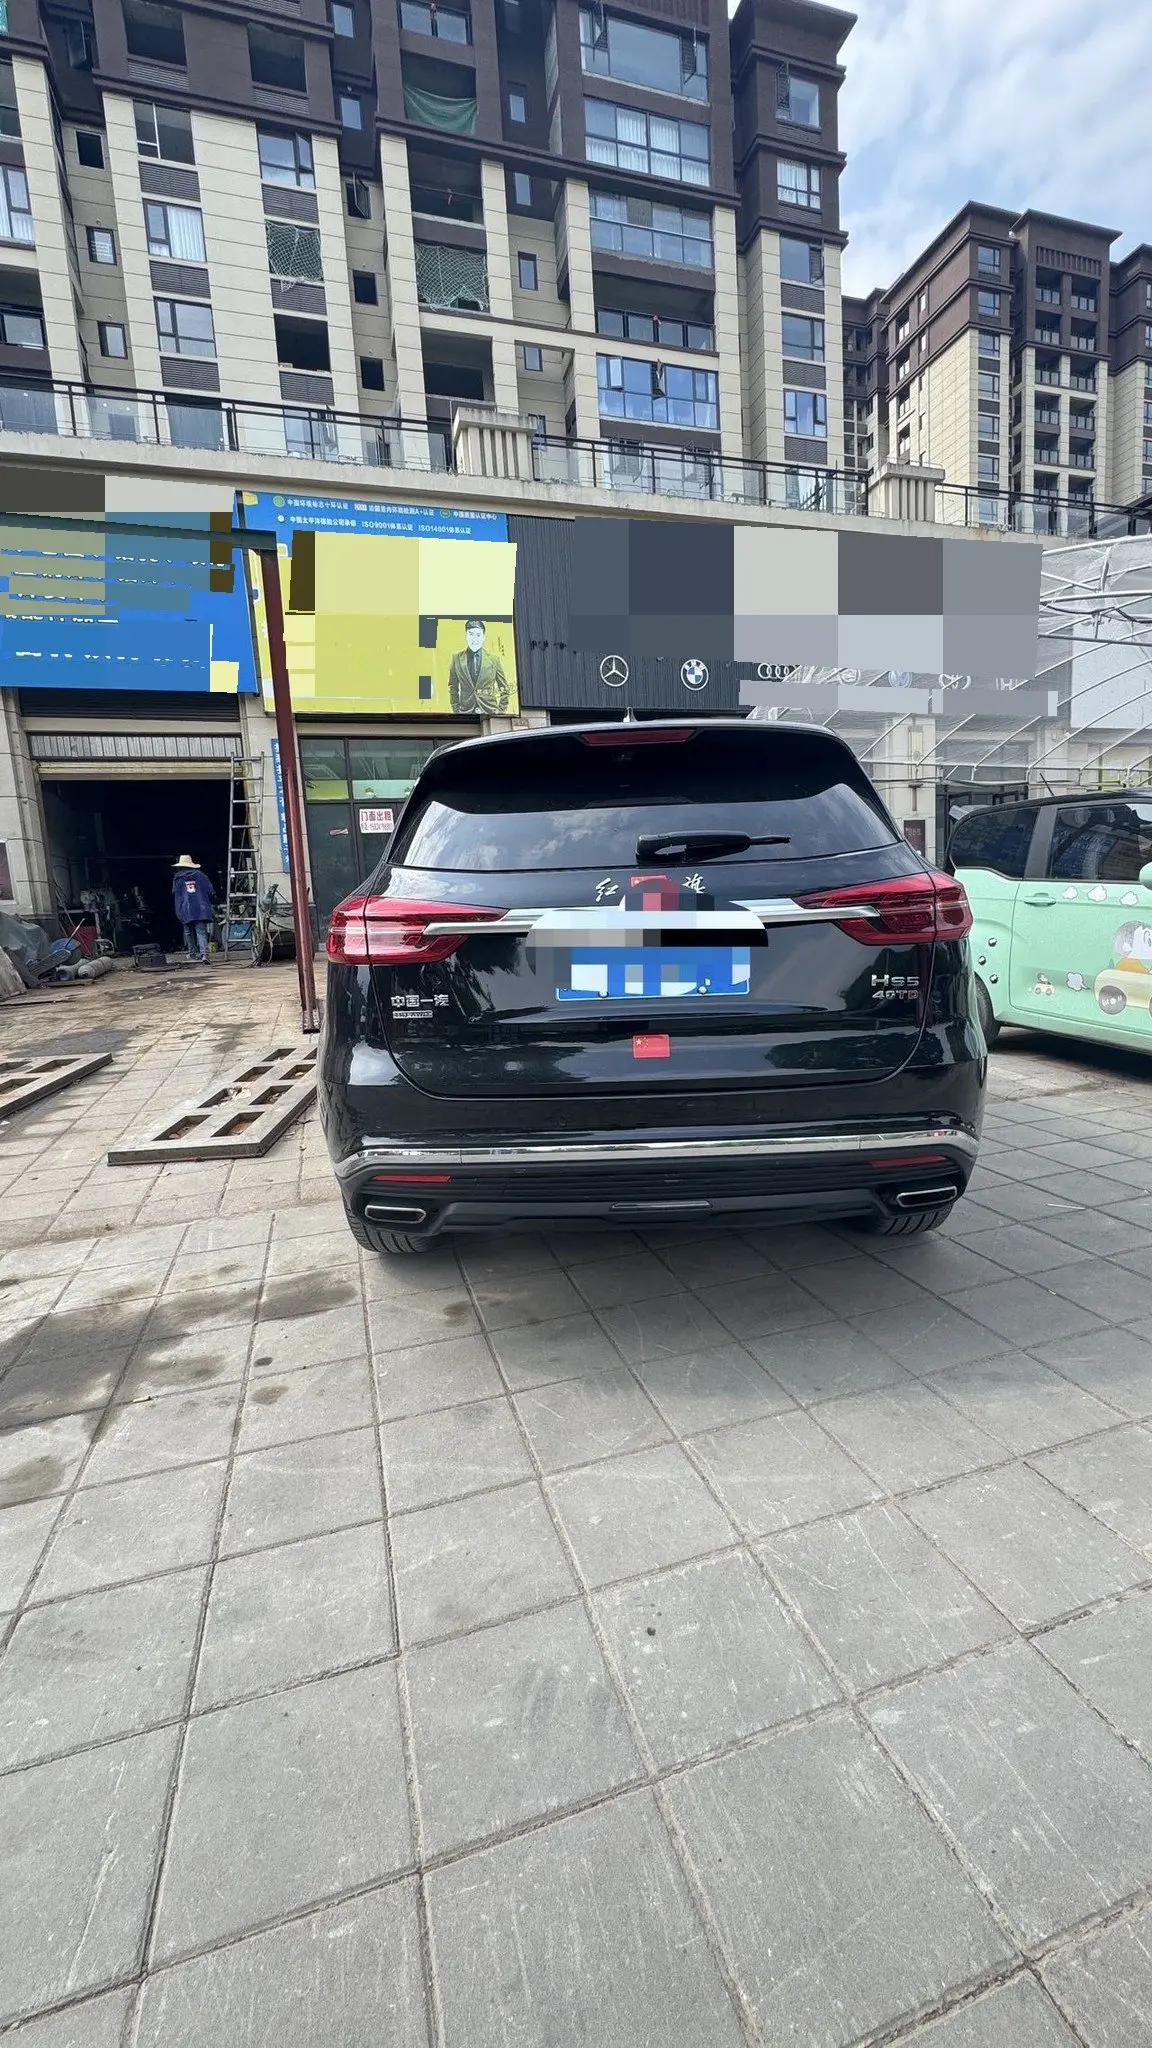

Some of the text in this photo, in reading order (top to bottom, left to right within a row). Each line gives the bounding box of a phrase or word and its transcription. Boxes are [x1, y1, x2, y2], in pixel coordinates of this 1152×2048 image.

[361, 811, 391, 821] 门面出租
[871, 974, 920, 987] HS5
[391, 994, 449, 1008] 中国一汽
